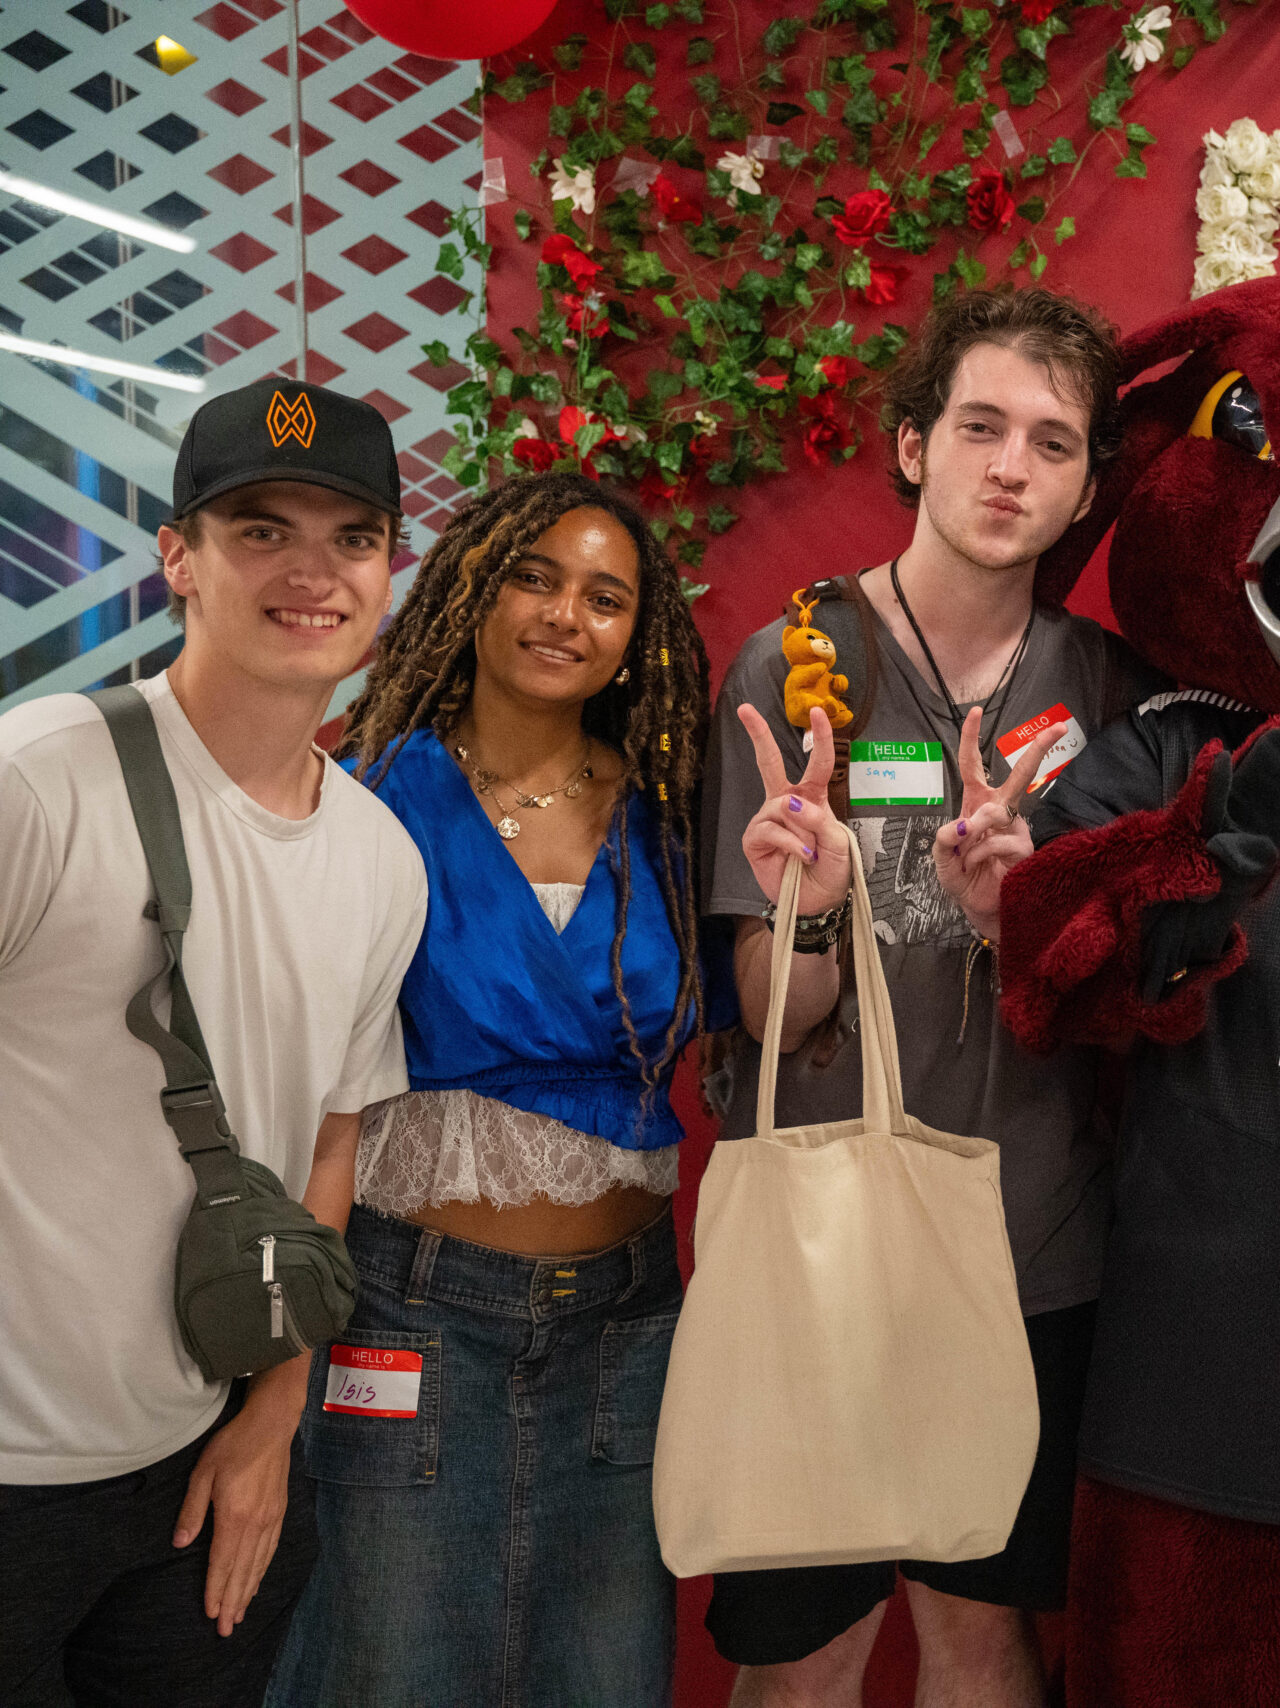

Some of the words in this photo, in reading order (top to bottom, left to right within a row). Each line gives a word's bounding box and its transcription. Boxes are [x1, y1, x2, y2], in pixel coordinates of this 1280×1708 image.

[1016, 716, 1049, 740] HELLO
[874, 744, 916, 755] HELLO
[351, 1350, 394, 1364] HELLO
[337, 1373, 376, 1403] Isis
